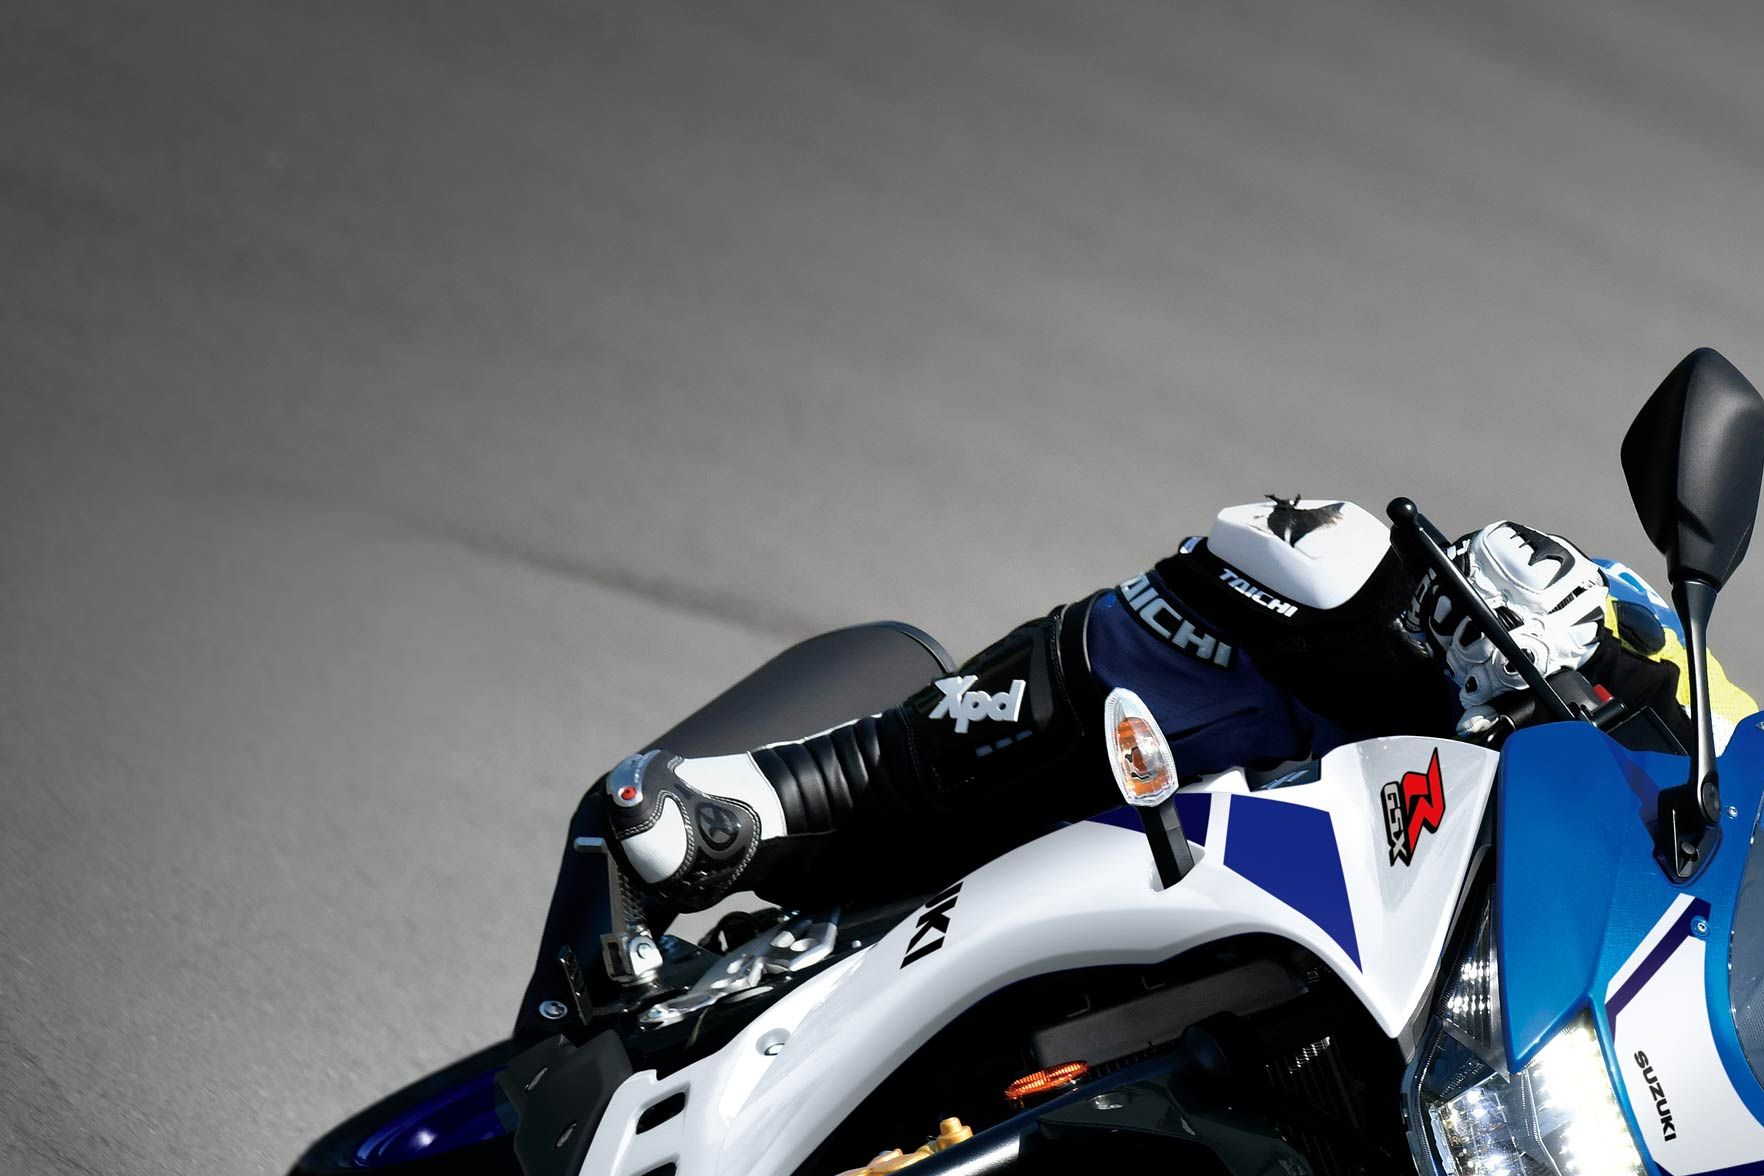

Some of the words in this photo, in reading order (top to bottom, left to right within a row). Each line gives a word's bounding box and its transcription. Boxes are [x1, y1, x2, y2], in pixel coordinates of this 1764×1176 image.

[1219, 568, 1299, 618] TAICHI
[928, 674, 1027, 734] Xpd
[1381, 781, 1410, 867] GSX
[1633, 1050, 1677, 1142] SUZUKI
